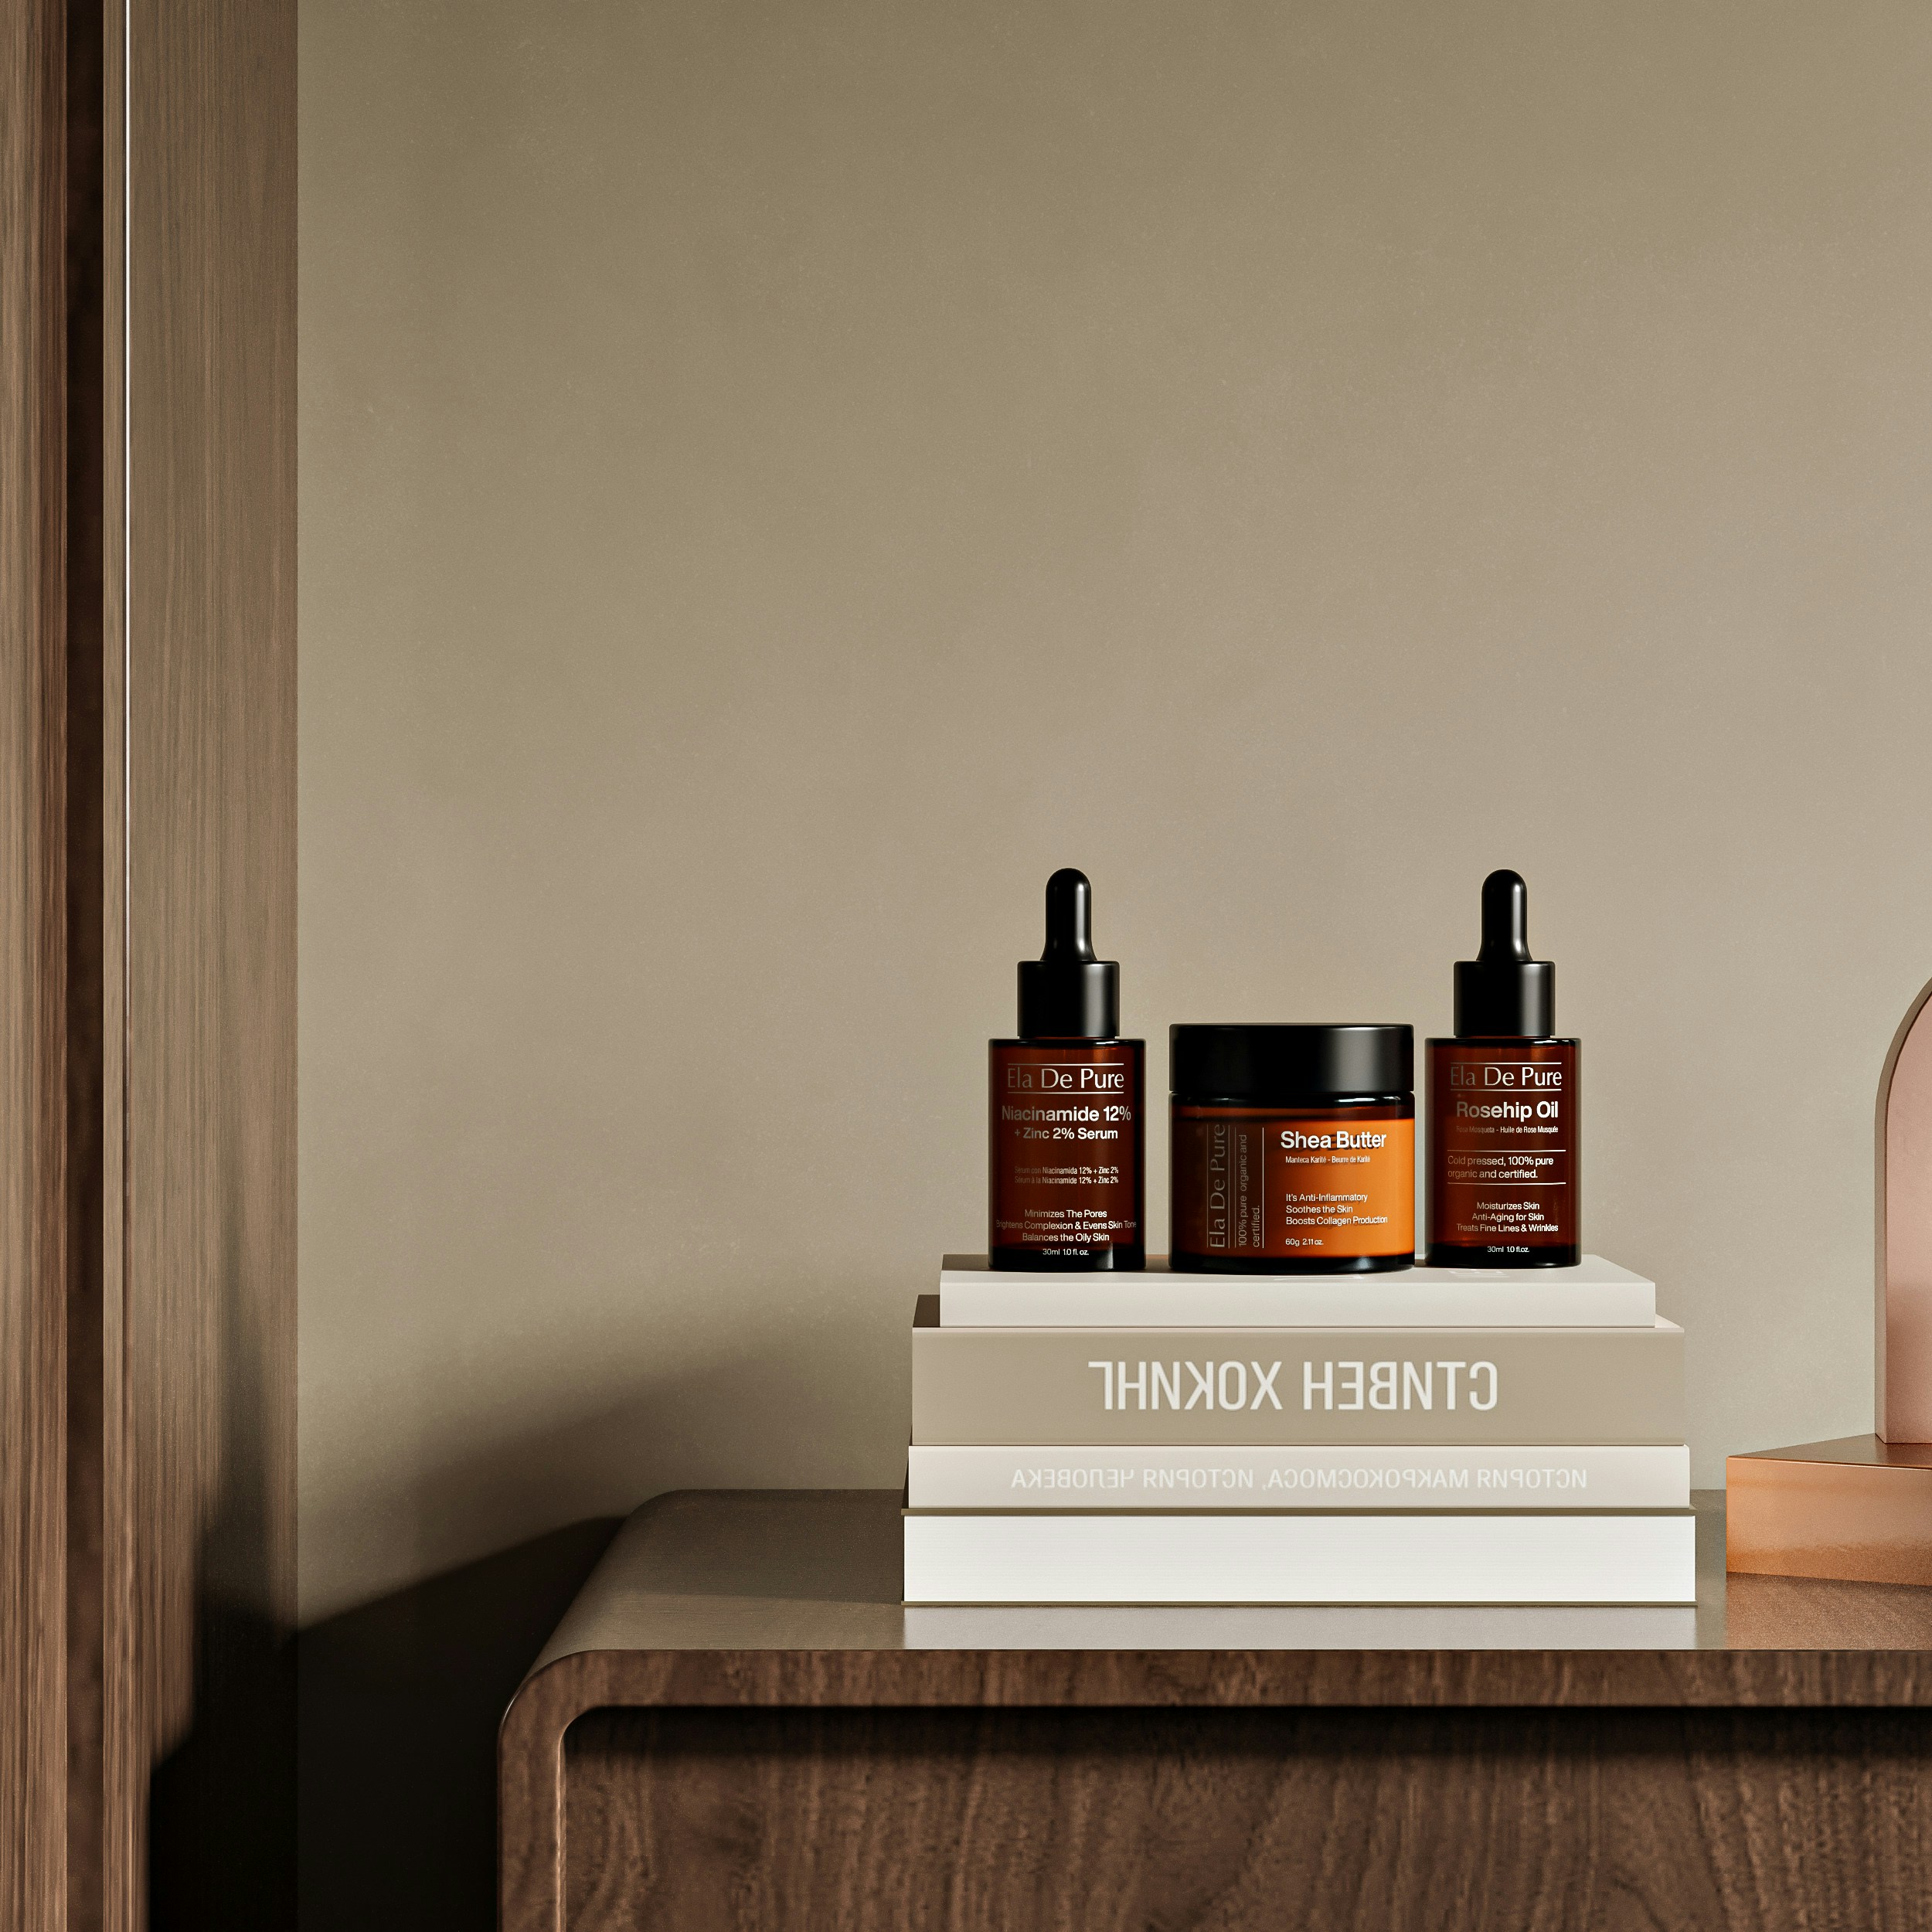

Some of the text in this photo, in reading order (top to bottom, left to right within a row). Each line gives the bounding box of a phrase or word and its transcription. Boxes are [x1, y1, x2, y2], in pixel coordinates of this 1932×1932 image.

[1008, 1066, 1124, 1089] Ela De Pure
[1451, 1066, 1563, 1087] Ela De Pure
[1002, 1105, 1131, 1121] Niacinamide 12%
[1457, 1101, 1559, 1122] Rosehip Oil
[1023, 1128, 1049, 1139] Zinc
[1053, 1128, 1075, 1139] 2%
[1077, 1128, 1118, 1139] Serum
[1537, 1125, 1559, 1134] Musquée
[1281, 1131, 1387, 1149] Shea Butter
[1447, 1155, 1553, 1167] Cold pressed, 100% pure
[1447, 1169, 1538, 1179] organic and certified.
[1209, 1124, 1226, 1247] Ela De Pure
[1238, 1134, 1249, 1247] 100% pure organic and
[1286, 1192, 1368, 1203] It's Anti-Inflammatory
[1286, 1205, 1353, 1213] Soothes the Skin
[1477, 1202, 1540, 1210] Moisturizes Skin
[1025, 1209, 1107, 1218] Minimizes The Pores
[1471, 1213, 1515, 1223] Anti-Aging
[1528, 1213, 1545, 1221] Skin
[996, 1219, 1137, 1231] Brightens Complexion & Evens Skin Tone
[1251, 1205, 1260, 1247] certified.
[1286, 1216, 1388, 1227] Boosts Collagen Production
[1457, 1223, 1559, 1232] Treats Fine Lines & Wrinkles
[1022, 1233, 1110, 1243] Balances the Oily Skin
[1285, 1238, 1300, 1247] 60g
